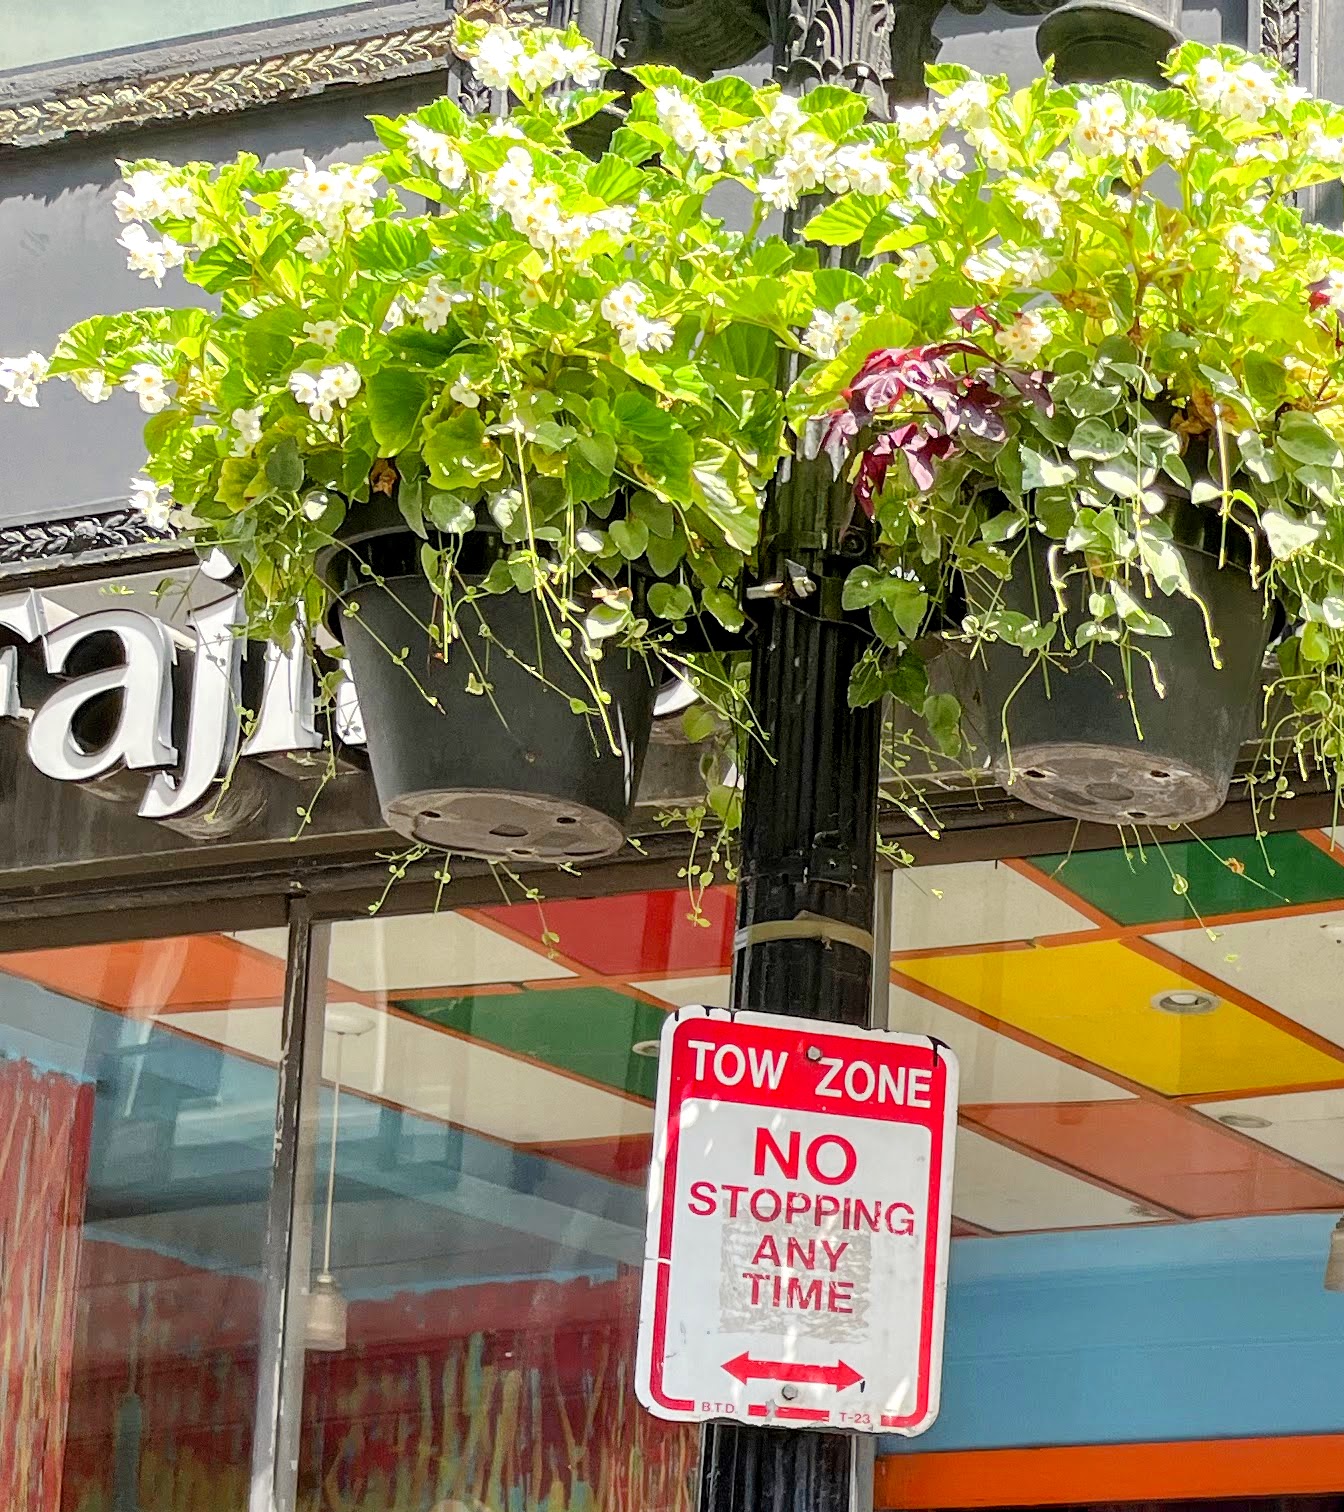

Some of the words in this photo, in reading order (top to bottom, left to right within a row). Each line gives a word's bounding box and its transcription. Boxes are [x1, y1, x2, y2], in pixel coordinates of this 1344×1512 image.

[687, 1040, 788, 1090] TOW
[814, 1057, 932, 1109] ZONE
[753, 1127, 857, 1185] NO
[688, 1181, 915, 1236] STOPPING
[751, 1234, 849, 1274] ANY
[742, 1272, 855, 1314] TIME
[701, 1401, 739, 1416] B.T.D.
[839, 1411, 871, 1425] T-23
